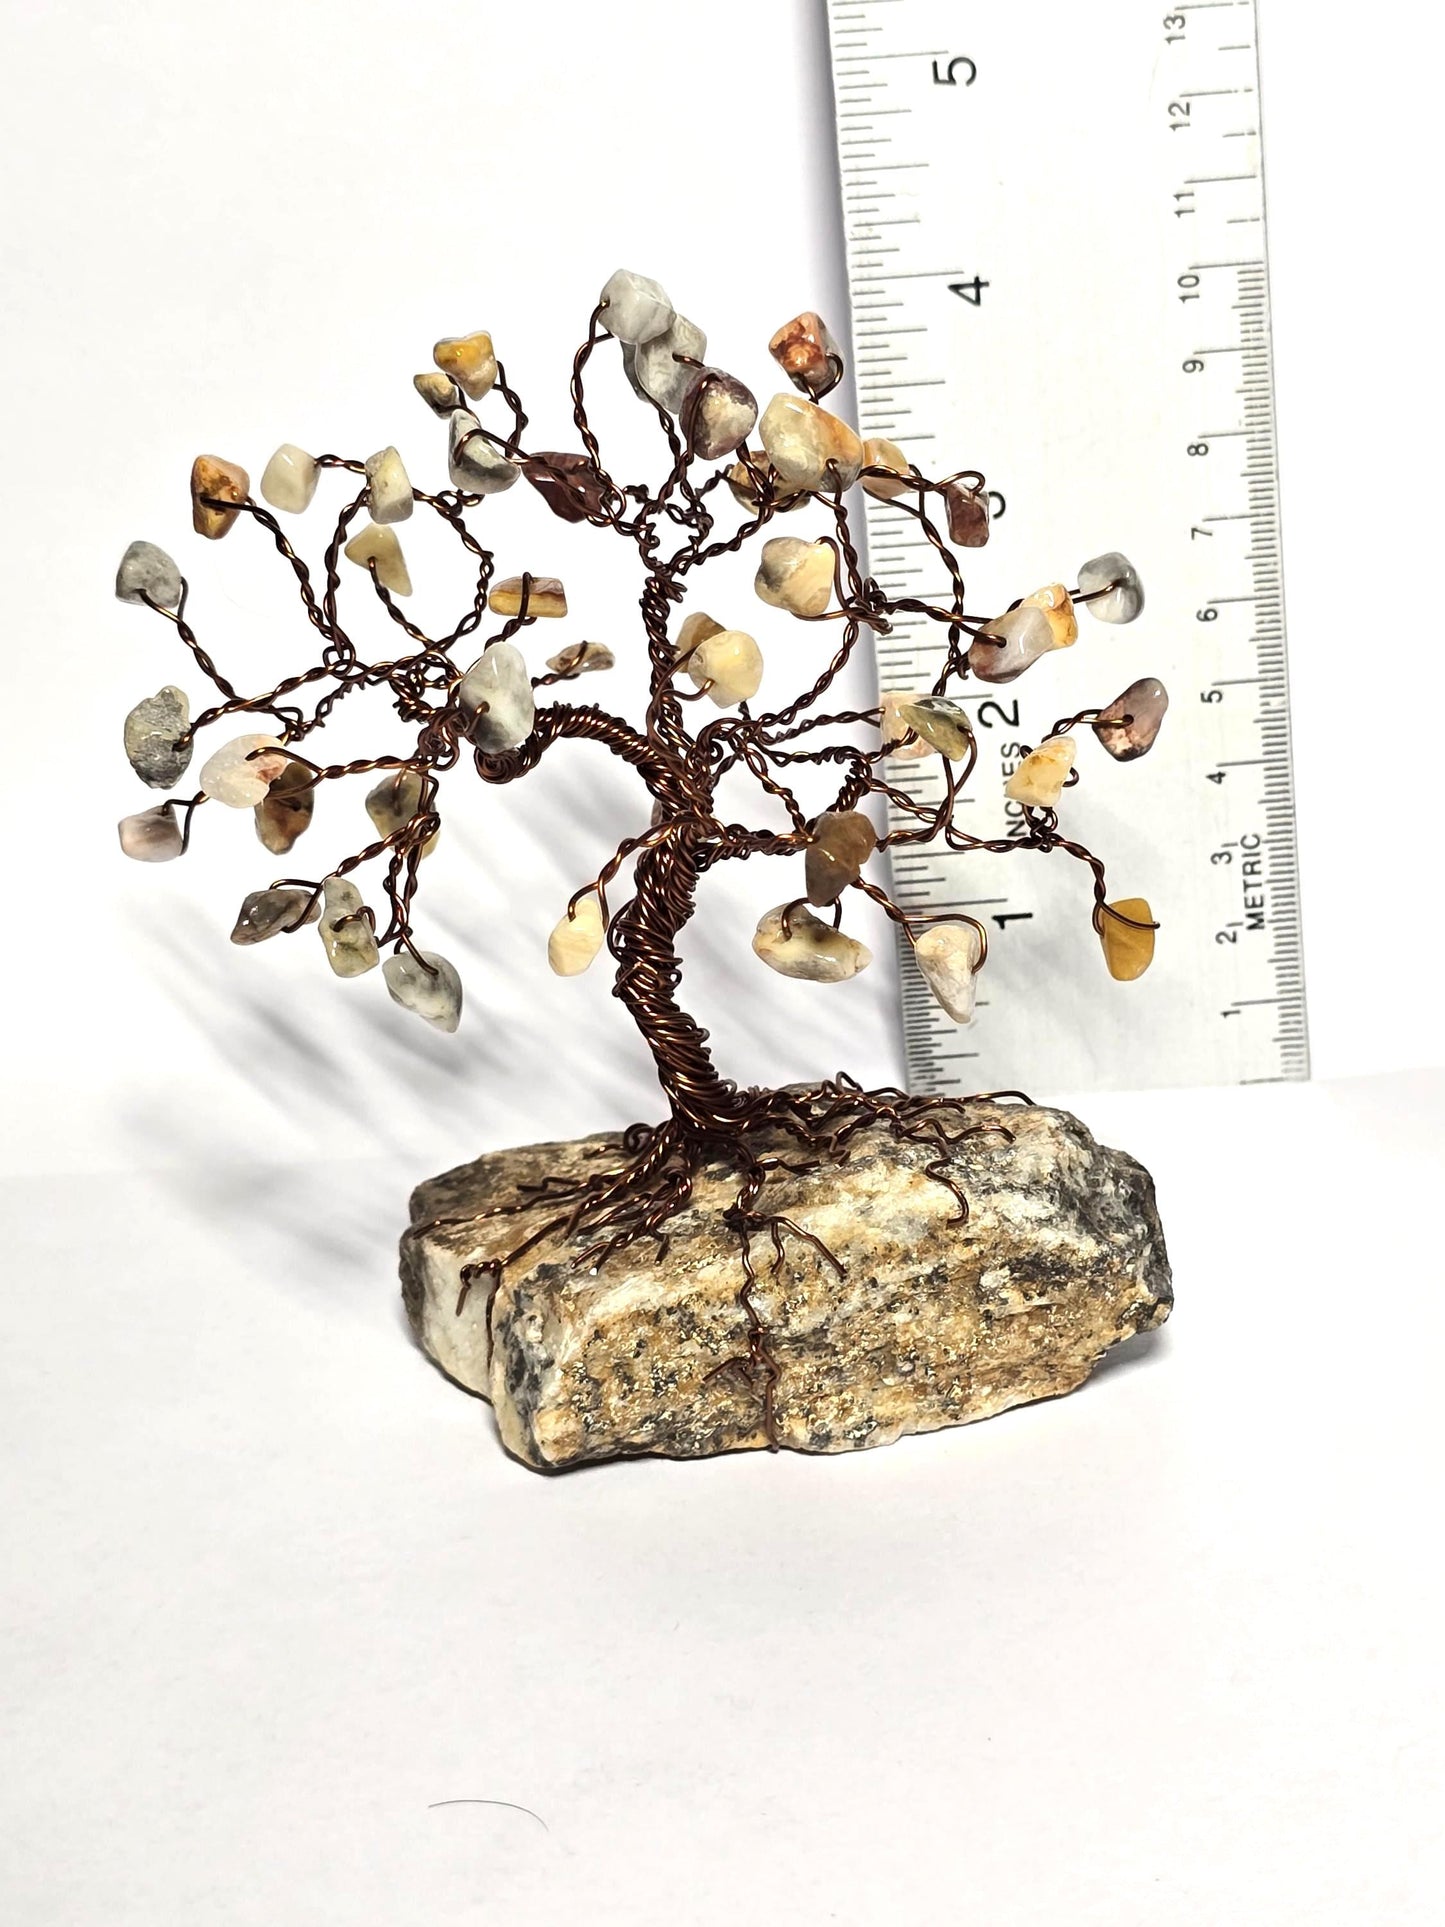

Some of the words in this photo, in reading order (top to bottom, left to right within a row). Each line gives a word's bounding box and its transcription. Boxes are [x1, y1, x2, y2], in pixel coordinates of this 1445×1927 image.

[1163, 14, 1186, 45] 13
[932, 56, 976, 87] 5
[1168, 102, 1190, 132] 12
[1173, 191, 1195, 218] 11
[948, 274, 990, 307] 4
[1177, 275, 1200, 304] 10
[1182, 359, 1205, 374] 9
[1187, 442, 1209, 457] 8
[1190, 527, 1212, 541] 7
[1197, 608, 1217, 622] 6
[1201, 689, 1222, 704] 5
[978, 699, 1019, 729] 2
[1206, 771, 1227, 785] 4
[1211, 851, 1232, 865] 3
[1241, 832, 1266, 931] METRIC
[992, 912, 1033, 930] 1
[1216, 931, 1237, 945] 2
[1221, 1010, 1241, 1018] 1
